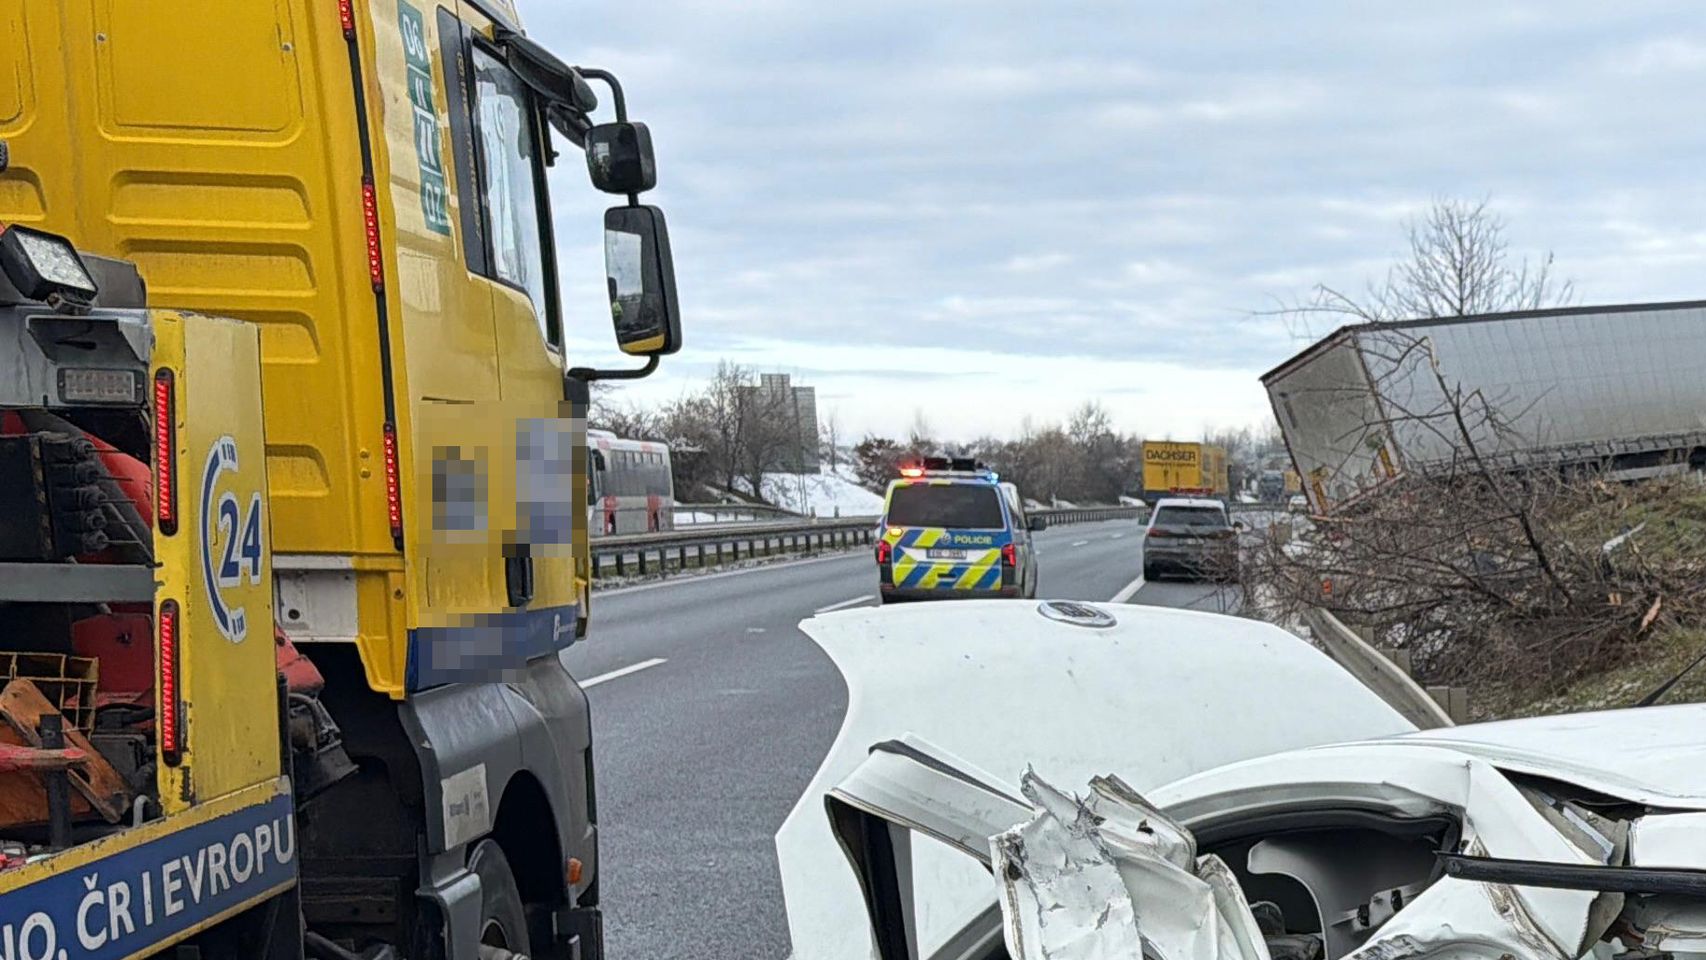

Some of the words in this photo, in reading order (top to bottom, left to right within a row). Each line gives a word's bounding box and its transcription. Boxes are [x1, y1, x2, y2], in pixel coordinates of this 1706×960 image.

[1146, 449, 1196, 461] DACHSER
[219, 494, 261, 581] 24
[954, 534, 993, 544] POLICIE
[77, 872, 135, 951] ČR
[142, 871, 153, 926] I
[162, 813, 295, 917] EVROPU
